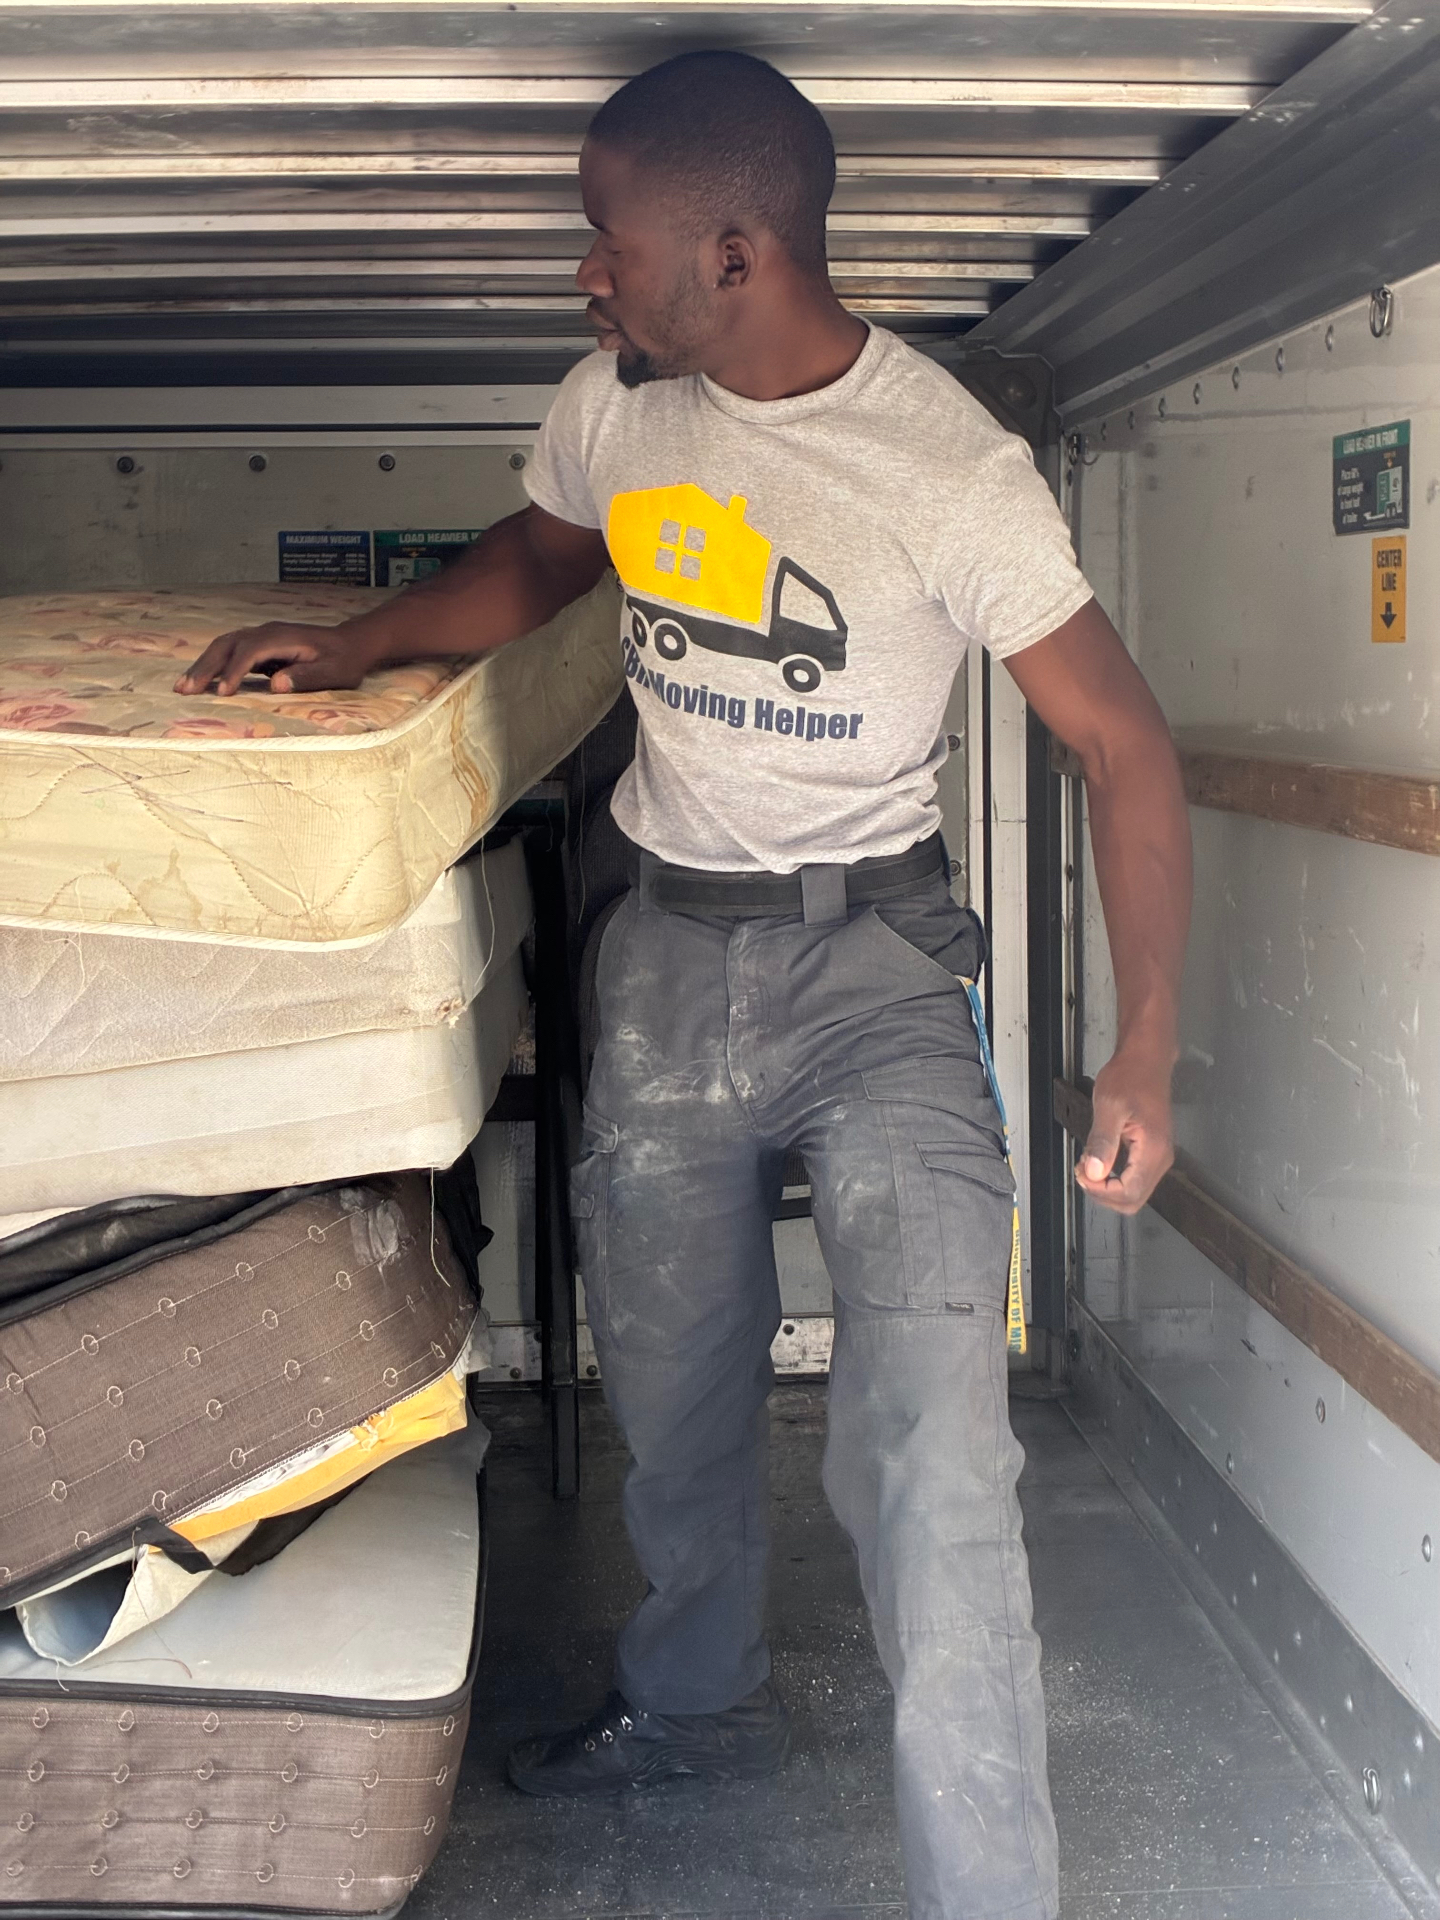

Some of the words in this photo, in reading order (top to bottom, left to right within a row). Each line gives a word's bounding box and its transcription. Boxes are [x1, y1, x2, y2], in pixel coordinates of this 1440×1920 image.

[286, 535, 328, 544] MAXIMUM
[329, 535, 361, 544] WEIGHT
[398, 534, 425, 543] LOAD
[426, 532, 468, 543] HEAVIER
[1377, 549, 1402, 568] CENTER
[1381, 572, 1396, 591] LINE
[647, 668, 746, 728] Moving
[754, 698, 863, 741] Helper
[1012, 1229, 1020, 1304] UNIVERSITY
[1012, 1308, 1021, 1323] OF
